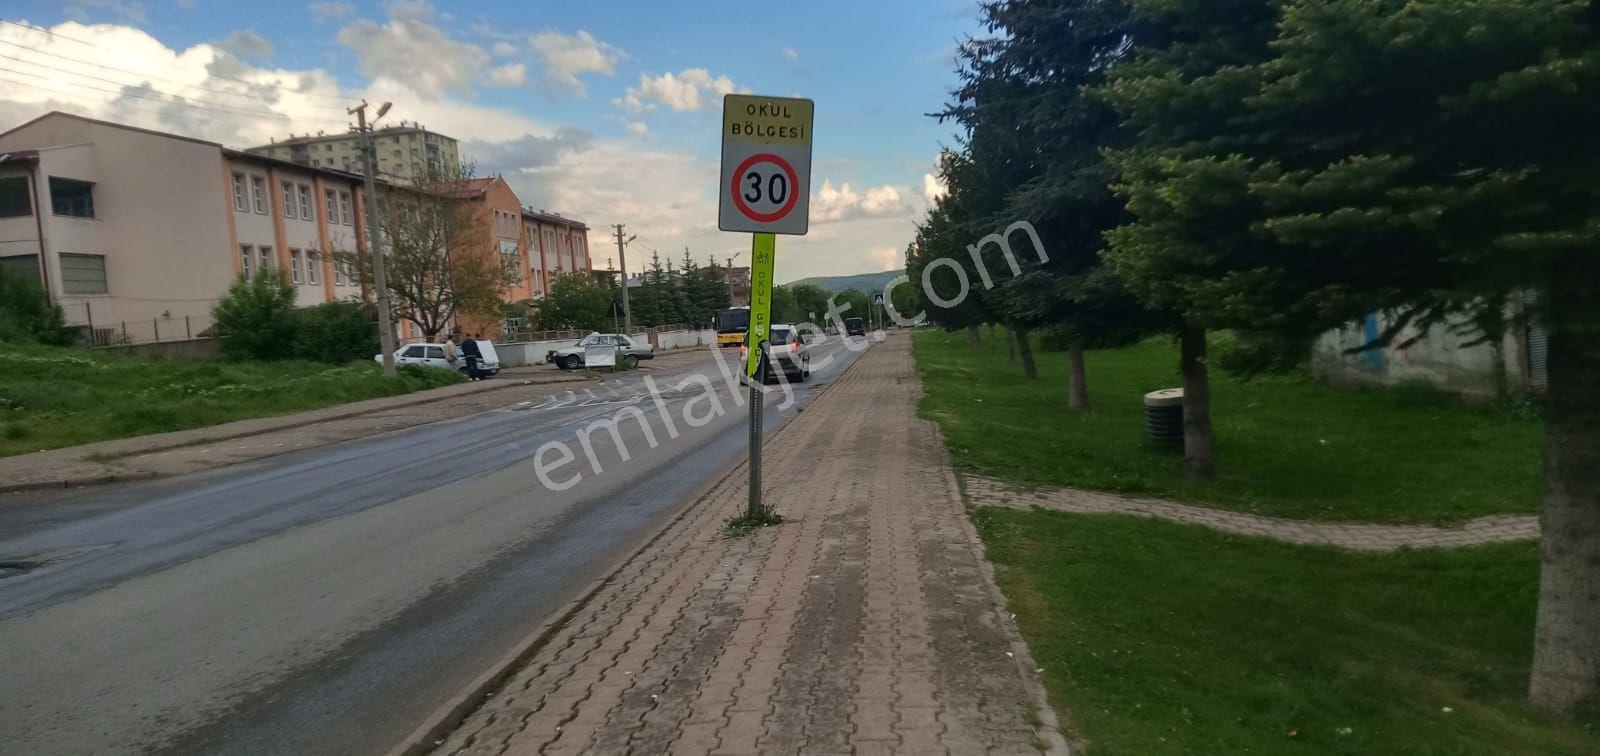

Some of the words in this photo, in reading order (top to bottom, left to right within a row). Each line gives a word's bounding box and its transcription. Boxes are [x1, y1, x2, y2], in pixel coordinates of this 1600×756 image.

[747, 104, 792, 118] OKUL
[732, 121, 804, 139] BÖLGESİ
[744, 171, 787, 205] 30
[758, 271, 766, 305] OKUL
